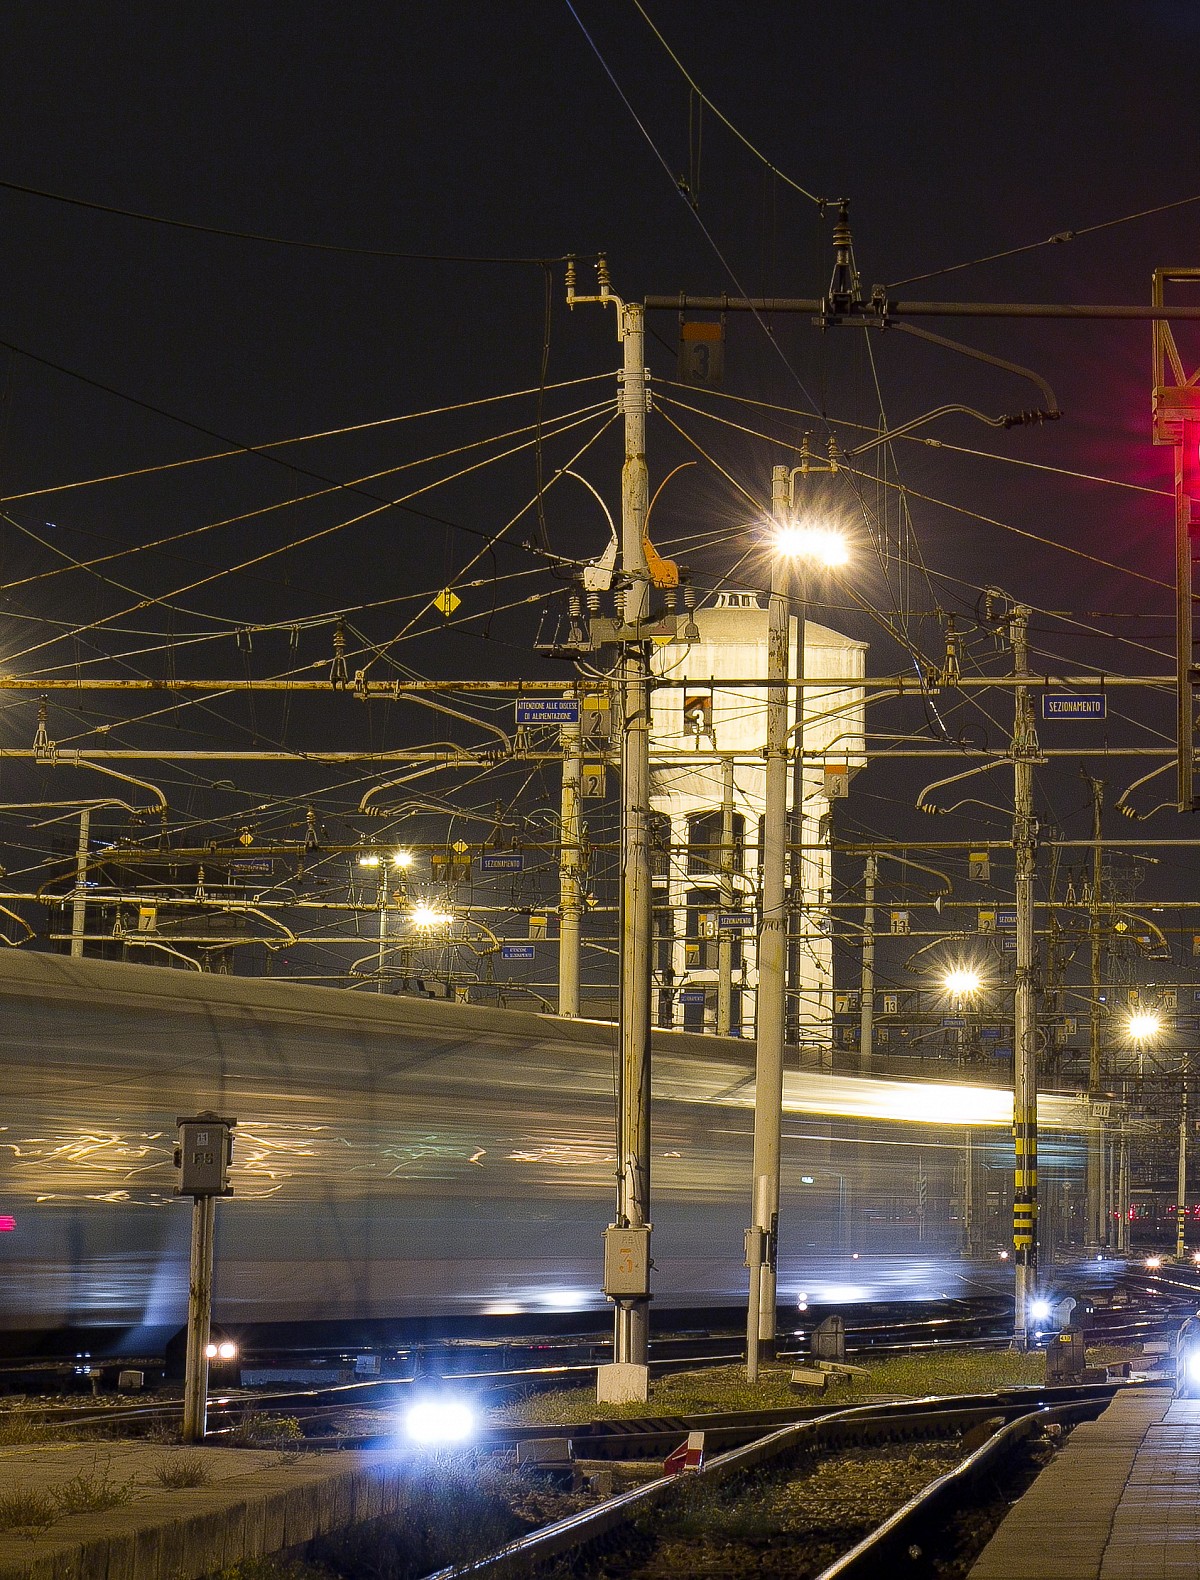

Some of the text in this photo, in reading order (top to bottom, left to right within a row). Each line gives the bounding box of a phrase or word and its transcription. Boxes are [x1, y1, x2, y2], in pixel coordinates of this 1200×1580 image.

[693, 343, 710, 380] 3
[1048, 701, 1101, 712] SEZIONAMENTO
[524, 712, 572, 720] DI ALIMENTAZIONE
[692, 709, 705, 734] 3
[590, 711, 603, 735] 2
[588, 776, 599, 797] 2
[484, 859, 520, 868] SEZIONAMENTO
[976, 863, 983, 878] 2
[145, 916, 151, 929] 7
[721, 917, 752, 925] SEZIONAMENTO
[893, 920, 907, 933] 13
[700, 922, 715, 936] 13
[688, 951, 696, 963] 7
[839, 1002, 845, 1012] 7
[885, 1002, 897, 1012] 13
